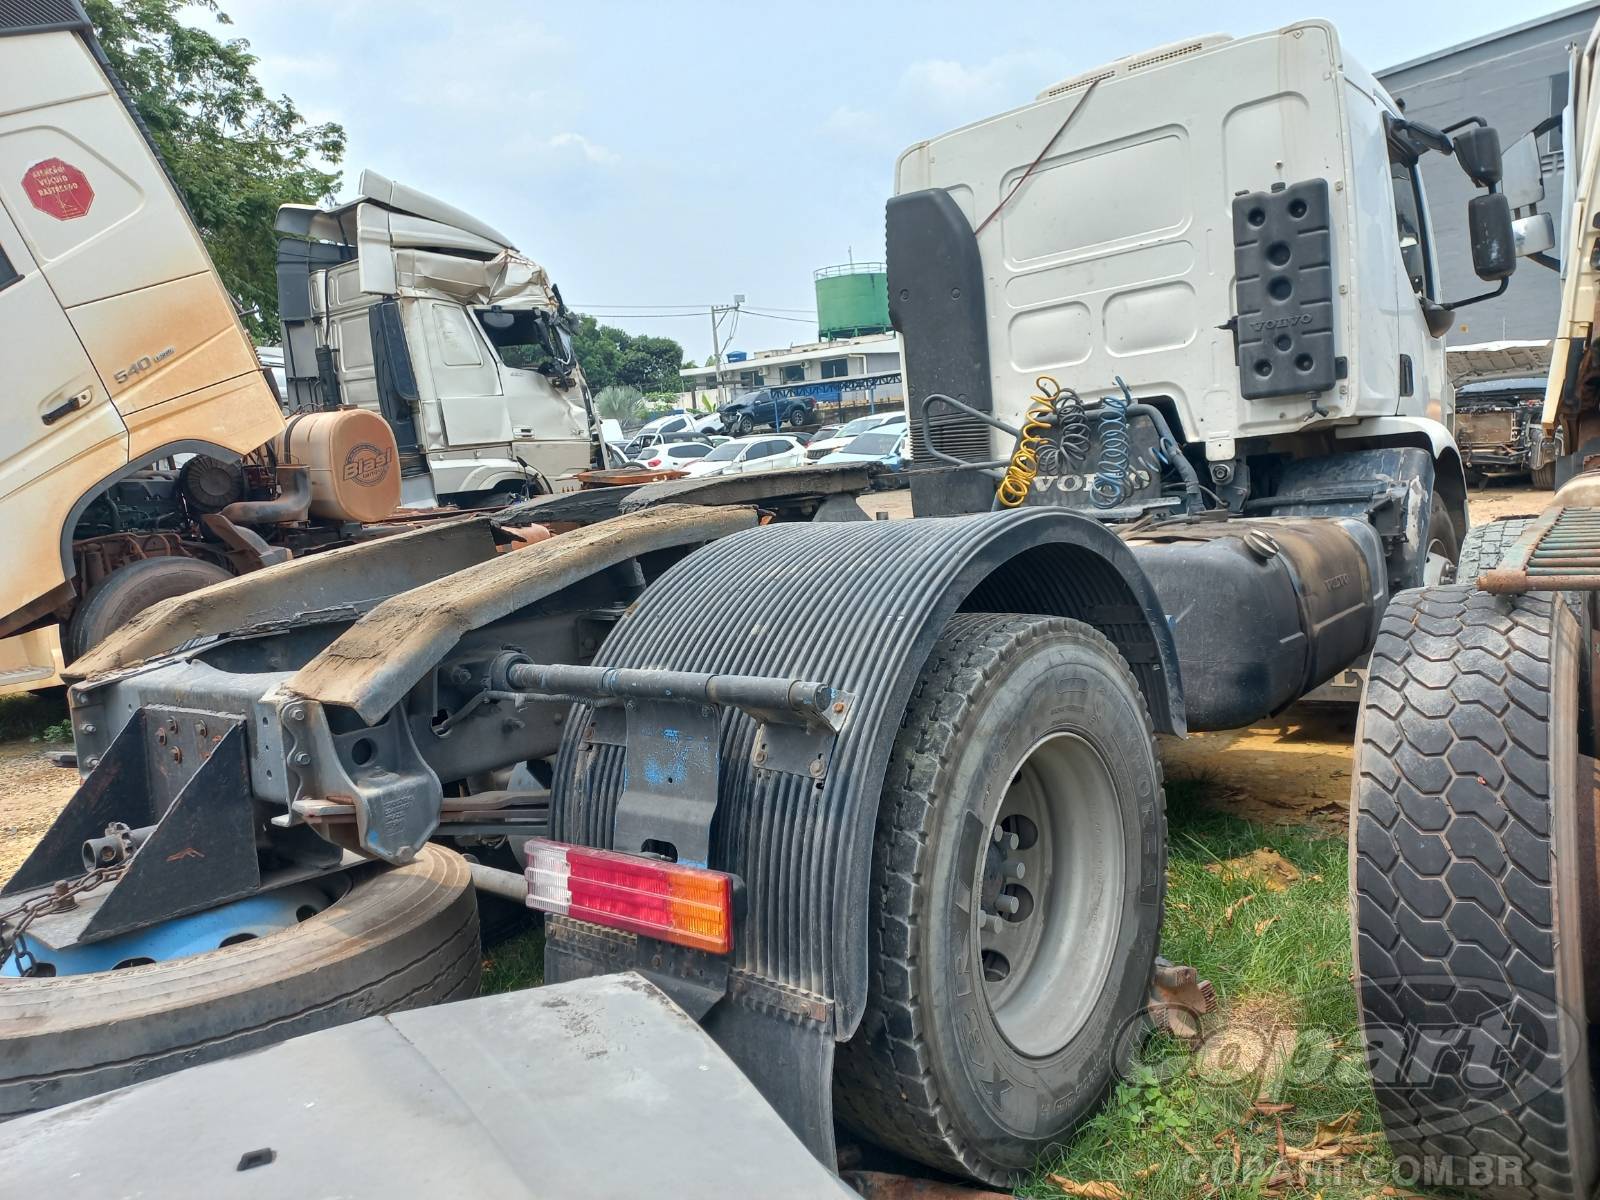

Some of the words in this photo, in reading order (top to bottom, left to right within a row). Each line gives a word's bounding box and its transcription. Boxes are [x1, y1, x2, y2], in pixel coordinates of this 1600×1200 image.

[1249, 313, 1312, 332] VOLVO
[113, 356, 151, 384] 540
[1033, 470, 1150, 492] VOLO
